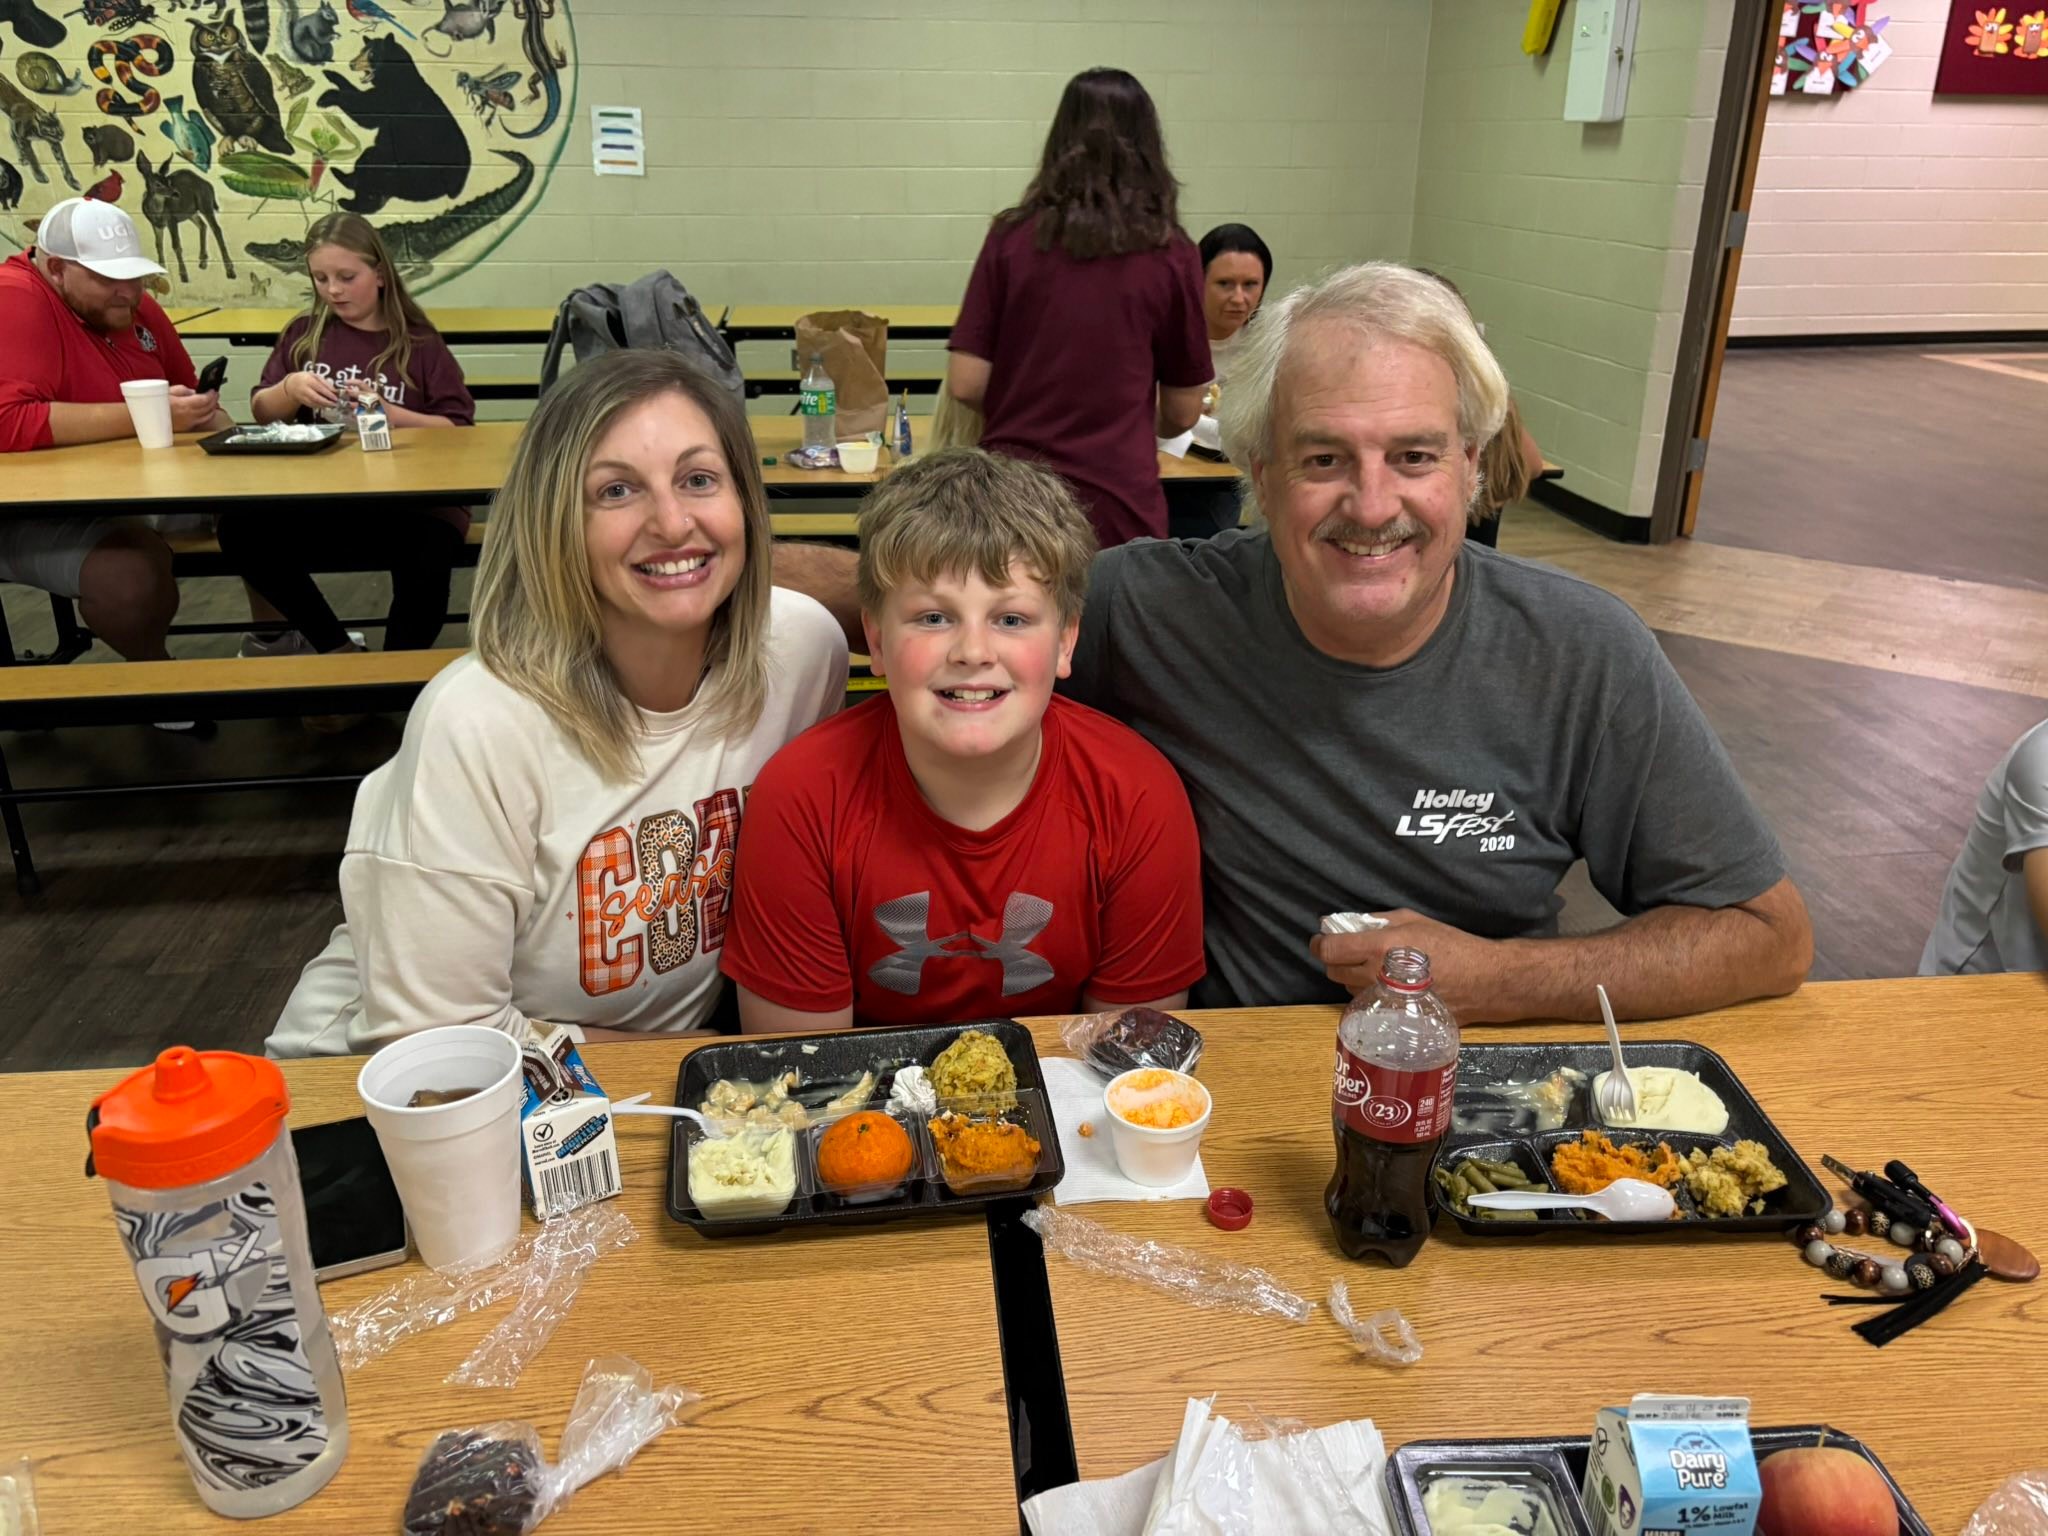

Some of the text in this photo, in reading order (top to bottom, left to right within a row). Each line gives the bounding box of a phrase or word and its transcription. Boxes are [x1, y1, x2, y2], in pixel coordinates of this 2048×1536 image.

[1412, 789, 1495, 814] Holley
[1479, 834, 1515, 853] 2020
[576, 784, 753, 997] COZ
[599, 848, 735, 938] seaso
[1374, 1103, 1395, 1120] 23
[1420, 1097, 1433, 1108] 240
[557, 1114, 608, 1158] MIGHTIEST
[570, 1124, 604, 1154] HEROES
[1669, 1448, 1726, 1474] Dairy
[1677, 1468, 1726, 1489] Pure
[1677, 1505, 1711, 1524] 1%
[1712, 1502, 1748, 1513] Lowfat
[1712, 1510, 1735, 1520] Milk
